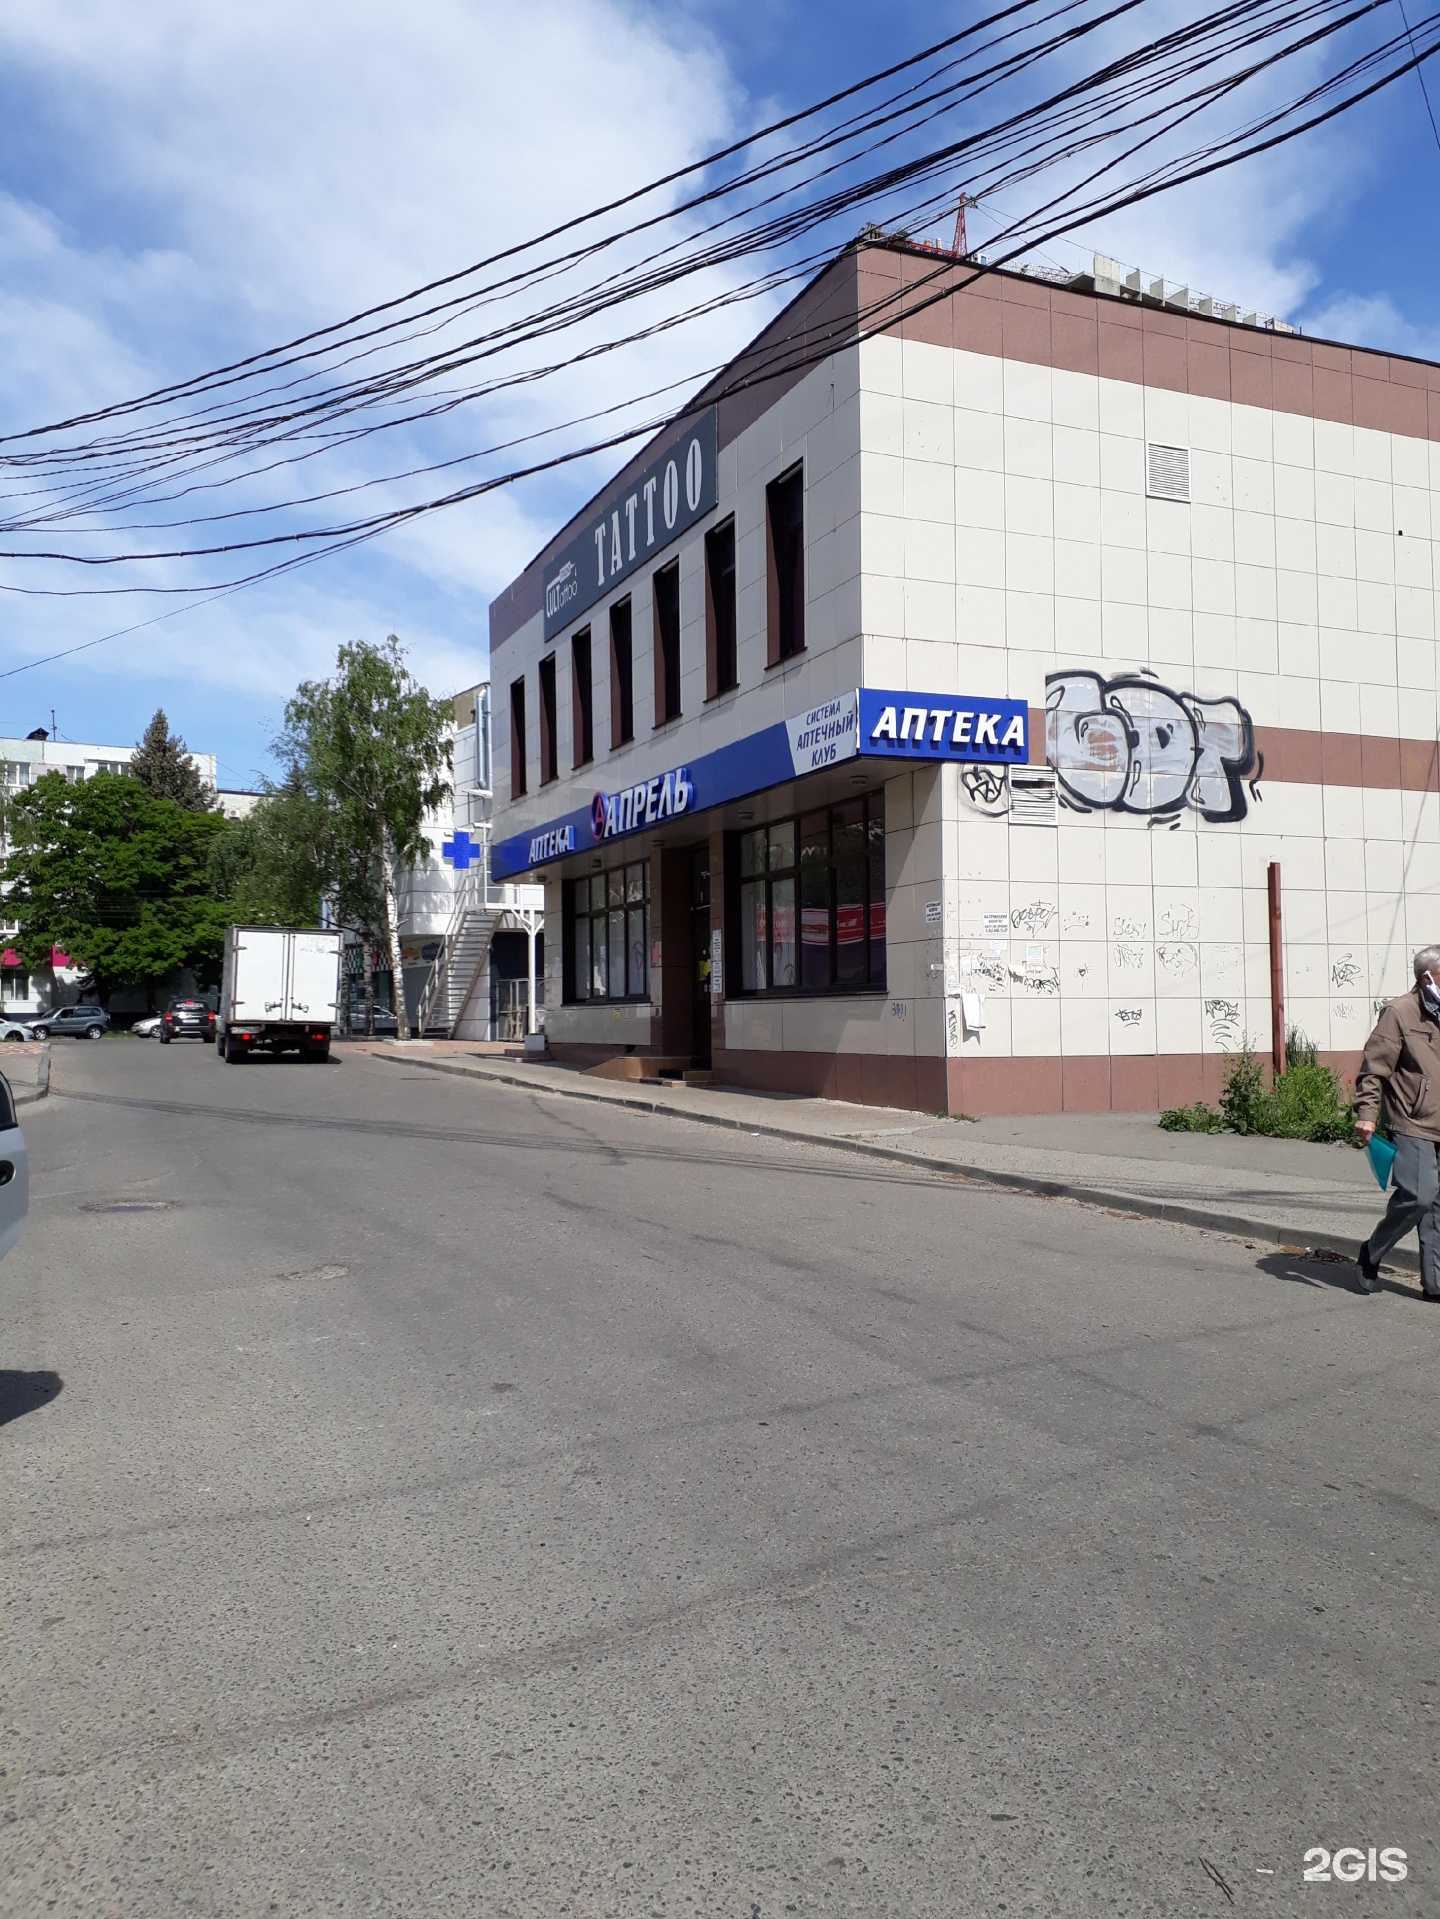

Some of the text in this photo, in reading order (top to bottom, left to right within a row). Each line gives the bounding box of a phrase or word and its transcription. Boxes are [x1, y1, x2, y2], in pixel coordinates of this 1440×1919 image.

[594, 438, 703, 586] TATTOO
[796, 710, 854, 751] АПТЕЧНЫЙ
[806, 699, 841, 726] СИСТЕМА
[871, 706, 1025, 747] АПТЕКА
[811, 743, 837, 767] КЛУБ
[604, 767, 691, 838] АПРЕЛЬ
[528, 825, 576, 864] АПТЕКА
